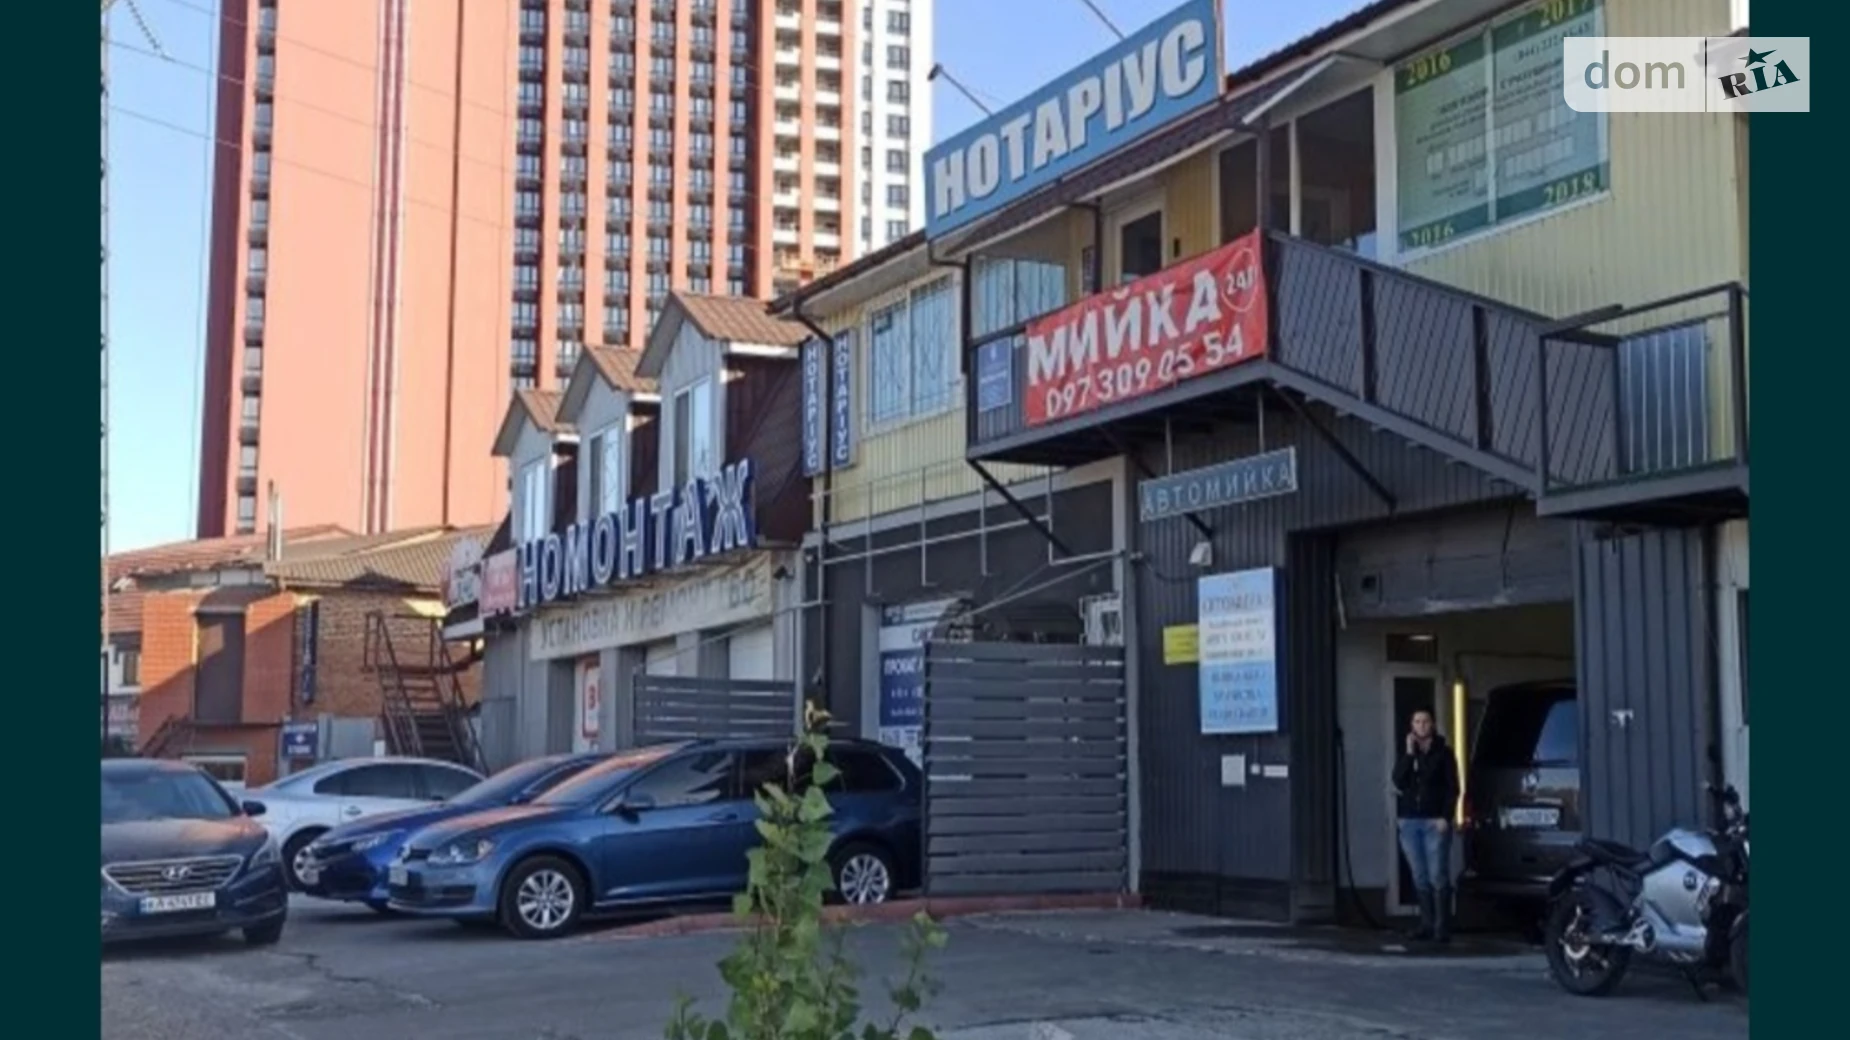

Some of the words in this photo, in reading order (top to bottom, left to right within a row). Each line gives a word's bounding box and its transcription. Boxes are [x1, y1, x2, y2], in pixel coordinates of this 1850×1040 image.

[933, 18, 1206, 219] НОТАРІУС
[1406, 53, 1452, 86] 2016
[1544, 171, 1597, 208] 2018
[1027, 267, 1222, 387] МИЙКА
[1046, 369, 1092, 418] 097
[1098, 356, 1151, 400] 309
[1203, 323, 1243, 366] 54
[806, 345, 818, 468] НОТАРІУС
[836, 336, 848, 460] НОТАРІУС
[518, 458, 754, 607] НОМОНТАЖ
[1142, 460, 1292, 515] АВТОМИЙКА
